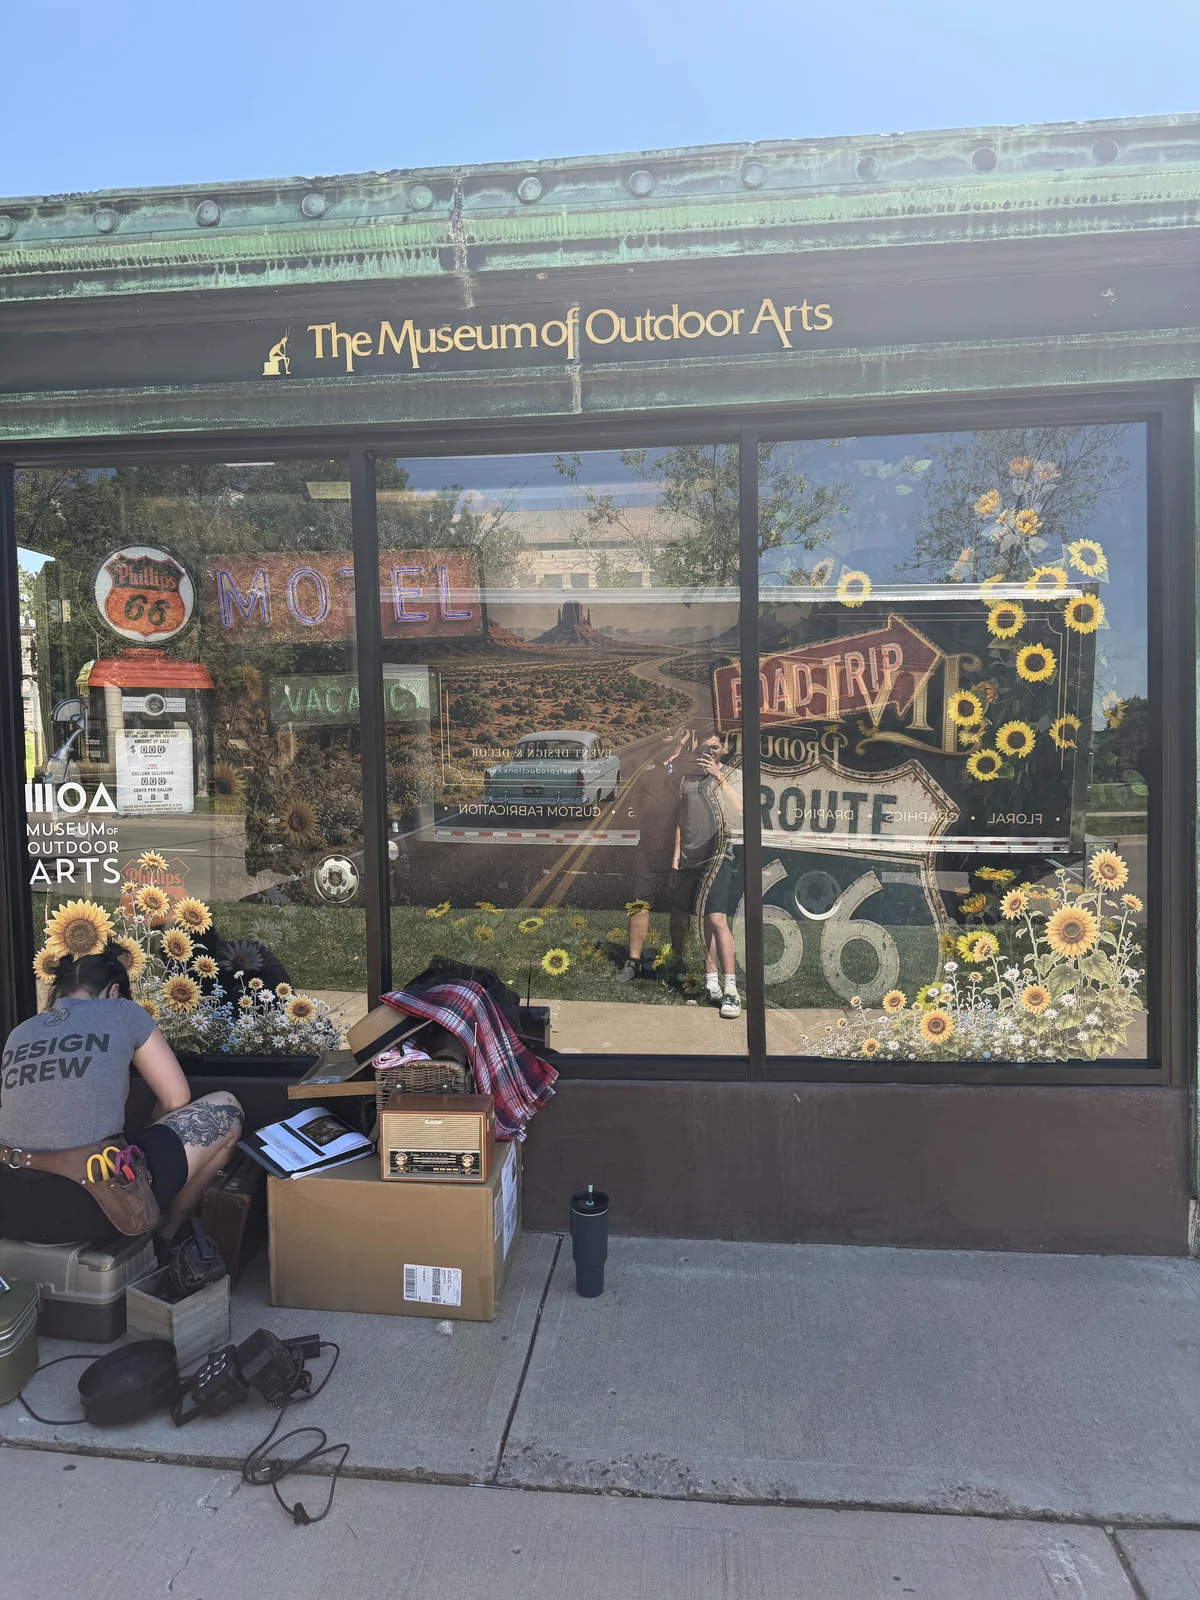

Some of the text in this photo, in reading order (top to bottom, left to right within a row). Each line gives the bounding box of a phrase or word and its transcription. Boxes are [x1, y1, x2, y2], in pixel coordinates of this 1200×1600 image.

[307, 298, 834, 373] The Museum of Outdoor Arts
[114, 563, 177, 592] Phillips
[124, 594, 171, 626] 66
[217, 566, 473, 628] MOEL
[822, 642, 904, 698] TRIP
[283, 682, 428, 717] VACACY
[130, 745, 136, 753] $
[26, 822, 119, 836] MUSEUM OF
[27, 841, 119, 855] OUTDOOR
[29, 857, 121, 885] ARTS
[732, 857, 900, 1002] 66
[2, 1033, 111, 1071] DESIGN
[4, 1056, 93, 1090] CREW
